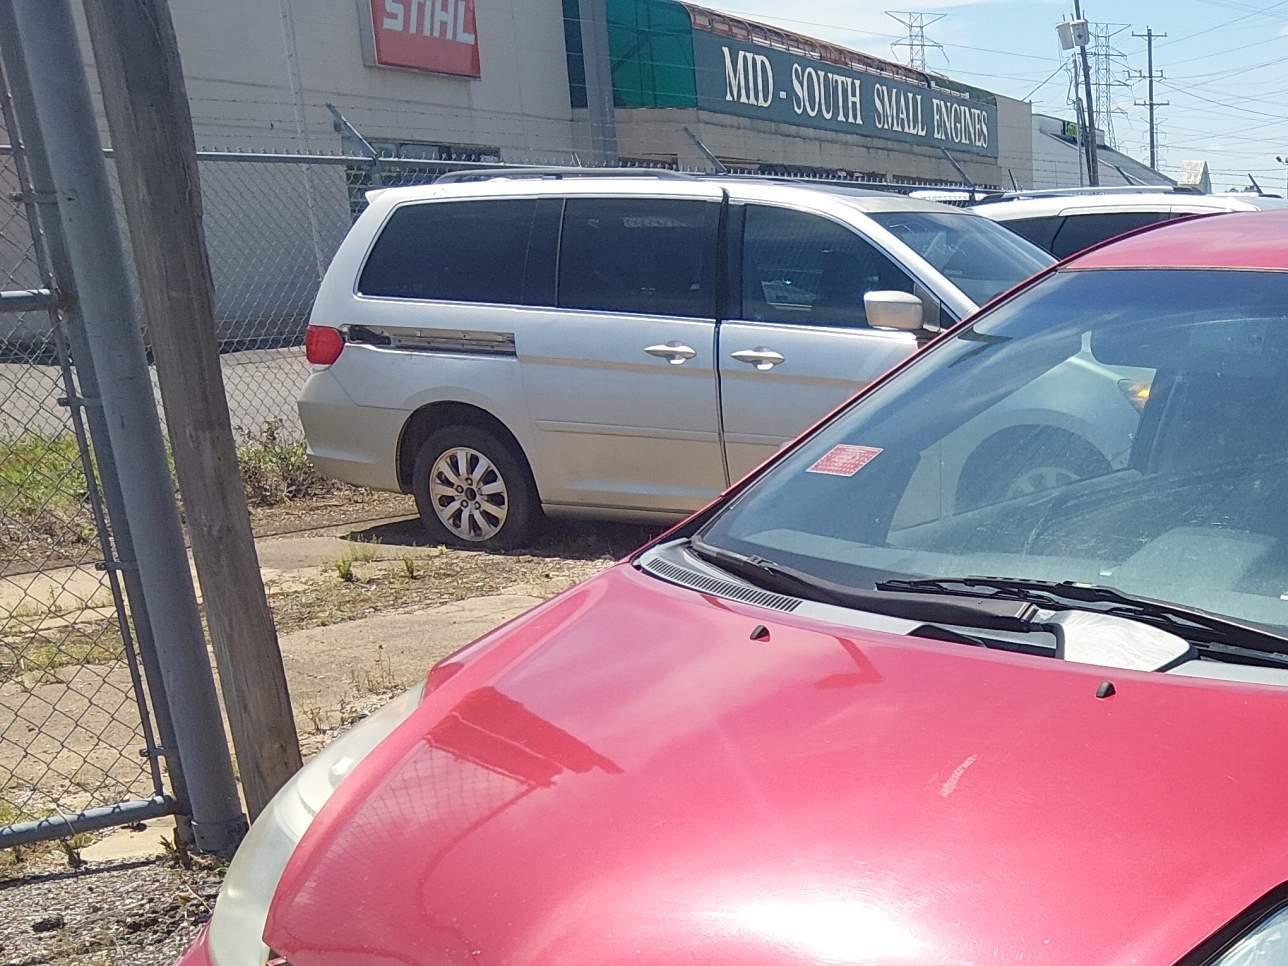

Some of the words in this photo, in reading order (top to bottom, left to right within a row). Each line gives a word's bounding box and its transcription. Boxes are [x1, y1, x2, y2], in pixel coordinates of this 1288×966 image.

[382, 0, 475, 45] STIHL
[722, 46, 774, 107] MID
[792, 63, 863, 125] SOUTH
[874, 83, 927, 137] SMALL
[932, 98, 988, 149] ENGINES
